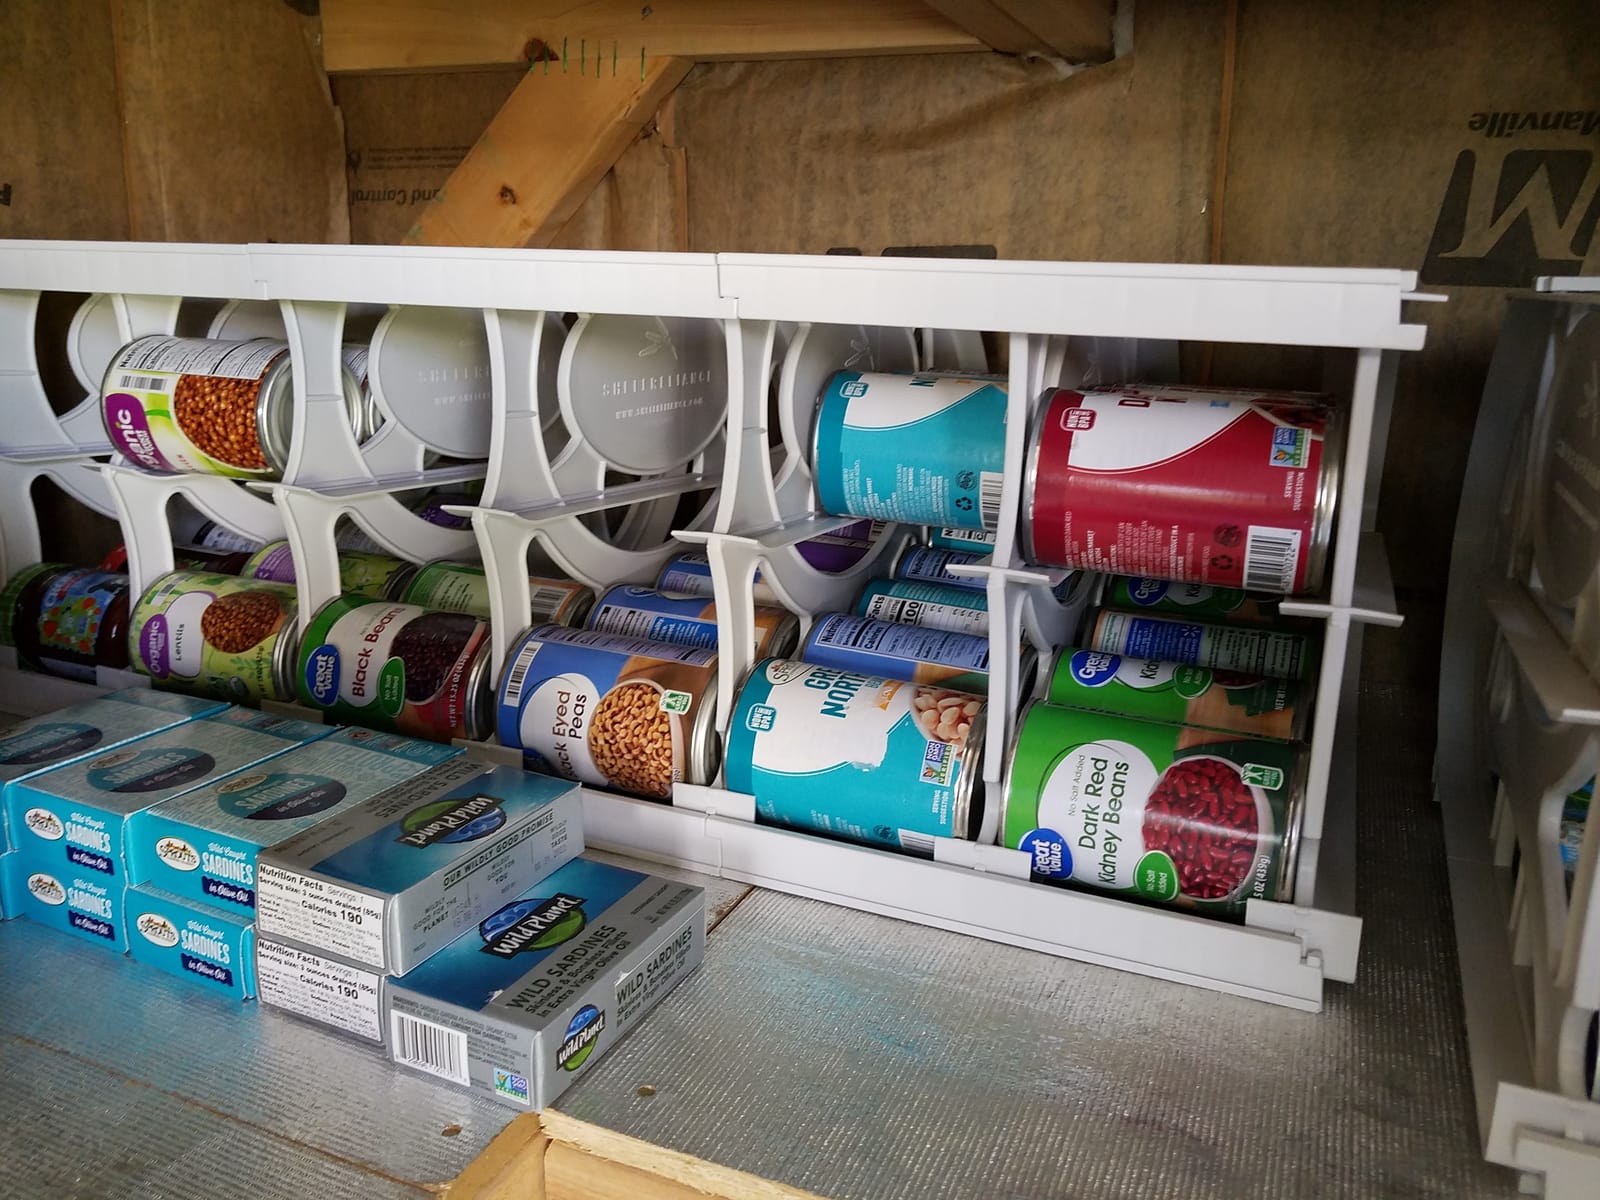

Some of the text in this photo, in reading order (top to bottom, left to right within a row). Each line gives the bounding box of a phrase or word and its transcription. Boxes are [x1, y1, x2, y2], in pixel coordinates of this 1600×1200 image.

[1066, 415, 1078, 428] NON
[116, 408, 160, 468] ganic
[1284, 471, 1295, 499] SERVING
[1293, 471, 1304, 511] SUGGESTION
[867, 596, 886, 618] Facts
[903, 602, 920, 625] 100
[175, 622, 186, 662] Lentils
[821, 614, 844, 643] Nutrition
[864, 627, 885, 650] Calories
[148, 619, 162, 674] Organic
[352, 648, 373, 698] Black
[363, 606, 407, 643] Beans
[313, 653, 329, 699] Great
[323, 653, 338, 691] Value
[803, 666, 843, 690] GRE
[1139, 660, 1160, 680] Kid
[568, 693, 588, 740] Peas
[751, 713, 761, 728] NON
[760, 714, 772, 729] BPA
[552, 690, 576, 777] ack Eyed
[925, 742, 934, 760] NON
[932, 744, 940, 761] GMO
[939, 746, 952, 785] VERIFIED
[103, 752, 188, 785] SARDINES
[447, 761, 485, 783] WILD
[234, 778, 317, 810] SARDINES
[374, 778, 446, 819] SARDINES
[1068, 754, 1086, 817] No Salt Added
[931, 790, 941, 814] SERVING
[940, 791, 950, 825] SUGGESTION
[1078, 757, 1109, 850] Dark Red
[405, 796, 493, 846] Wild Planet
[1098, 761, 1130, 885] Kidney Beans
[65, 822, 111, 853] SARDINES
[207, 842, 247, 861] Wild Caught
[443, 812, 554, 887] OUR WILDLY GOOD PROMISE
[551, 834, 568, 848] TASTE
[202, 852, 253, 885] SARDINES
[1032, 838, 1050, 875] Great
[1049, 842, 1063, 873] Value
[1257, 854, 1271, 876] (439g)
[208, 883, 250, 902] in Olive Oil
[260, 865, 298, 884] Nutrition
[299, 876, 324, 892] Facts
[1158, 872, 1168, 894] Added
[67, 887, 113, 919] SARDINES
[259, 876, 284, 891] Serving
[302, 889, 307, 897] 3
[335, 898, 362, 913] drained
[301, 899, 363, 926] Calories 190
[423, 911, 449, 933] PLANET
[492, 895, 573, 955] Wild Planet
[186, 920, 225, 939] Wild Caught
[181, 930, 231, 965] SARDINES
[258, 940, 295, 959] Nutrition
[297, 952, 320, 967] Facts
[258, 951, 283, 965] Serving
[188, 960, 228, 981] in Olive Oil
[505, 924, 618, 1009] WILD SARDINES
[525, 930, 629, 1015] Skinless & Boneless Fillets
[537, 939, 633, 1020] In Extra Virgin Olive Oil
[616, 925, 694, 1005] WILD SARDINES
[299, 974, 359, 1000] Calories 190
[616, 992, 643, 1017] Skinless
[558, 1014, 605, 1065] Wild Planet
